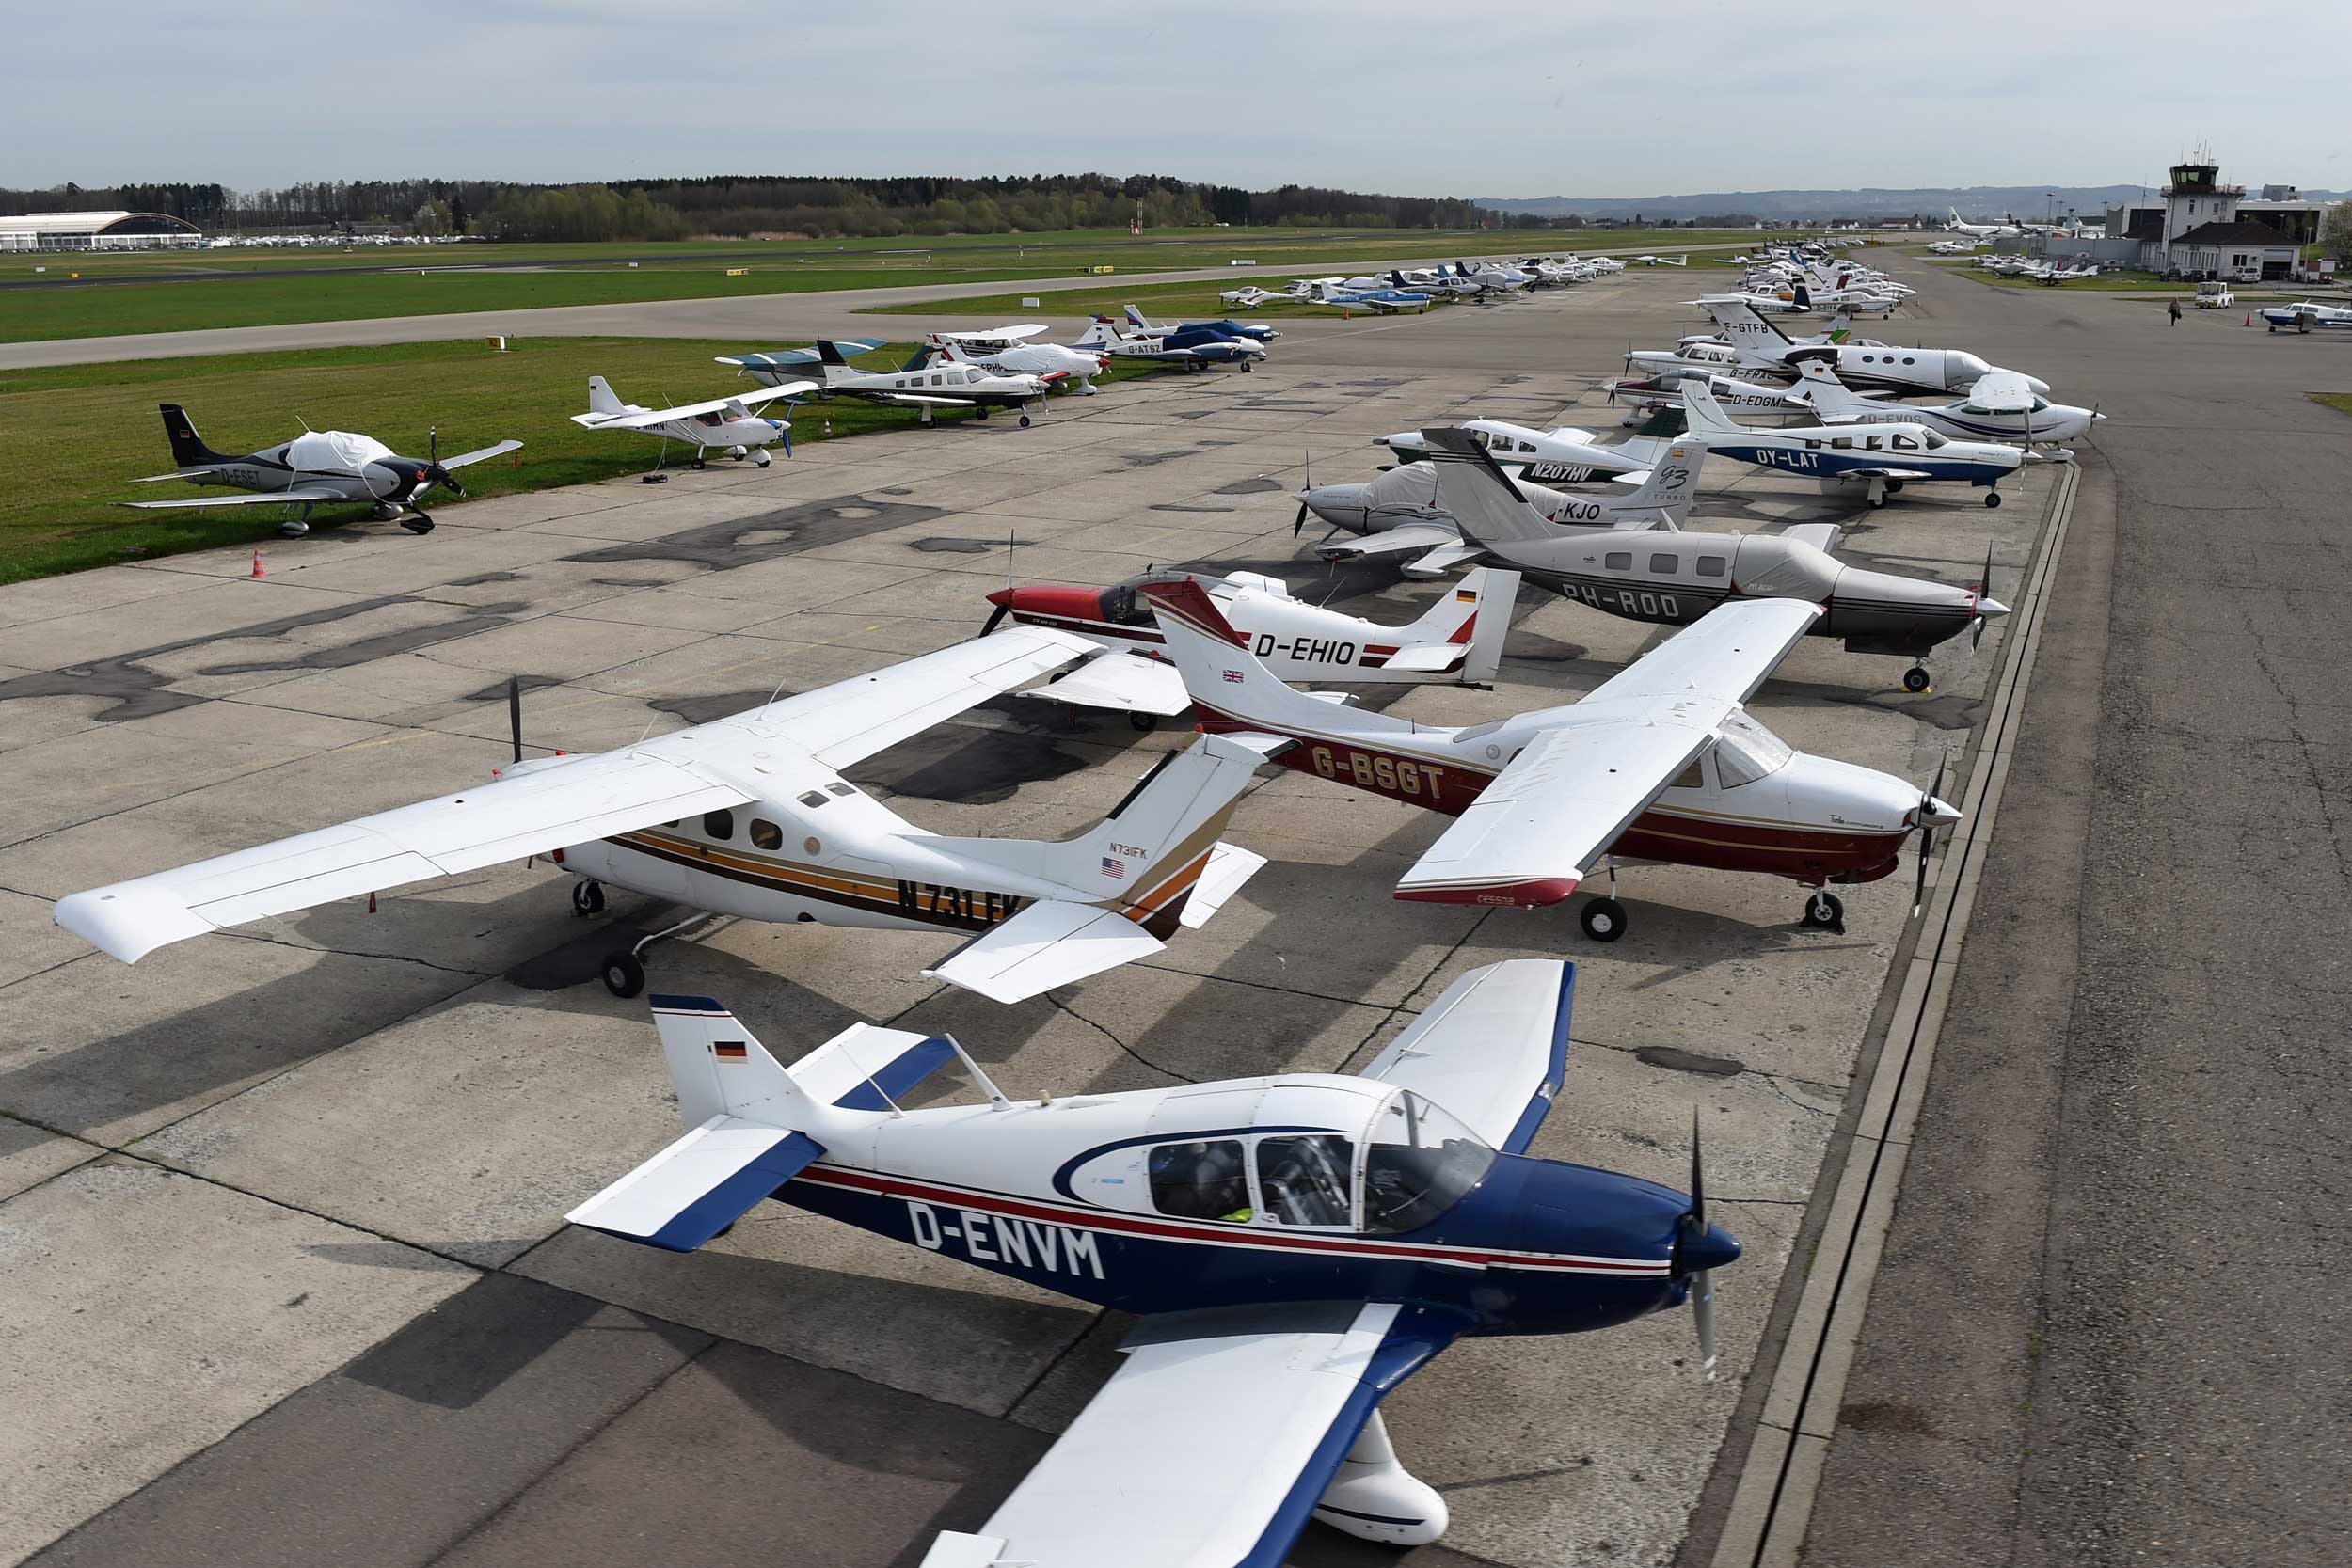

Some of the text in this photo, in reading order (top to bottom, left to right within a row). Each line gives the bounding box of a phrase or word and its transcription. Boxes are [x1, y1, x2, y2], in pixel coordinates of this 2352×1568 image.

[1128, 344, 1162, 354] G-ATSZ
[1733, 394, 1781, 408] D-EDGM
[1756, 450, 1818, 467] OY-LAT
[220, 468, 261, 484] D-ESET
[1530, 462, 1594, 482] N207HV
[1558, 502, 1601, 520] -KJO
[1562, 583, 1679, 618] PH-ROD
[1254, 633, 1356, 665] D-EHIO
[1312, 746, 1444, 799] G-BSGT
[1109, 842, 1148, 859] N731FK
[907, 1201, 1105, 1279] D-ENVM
